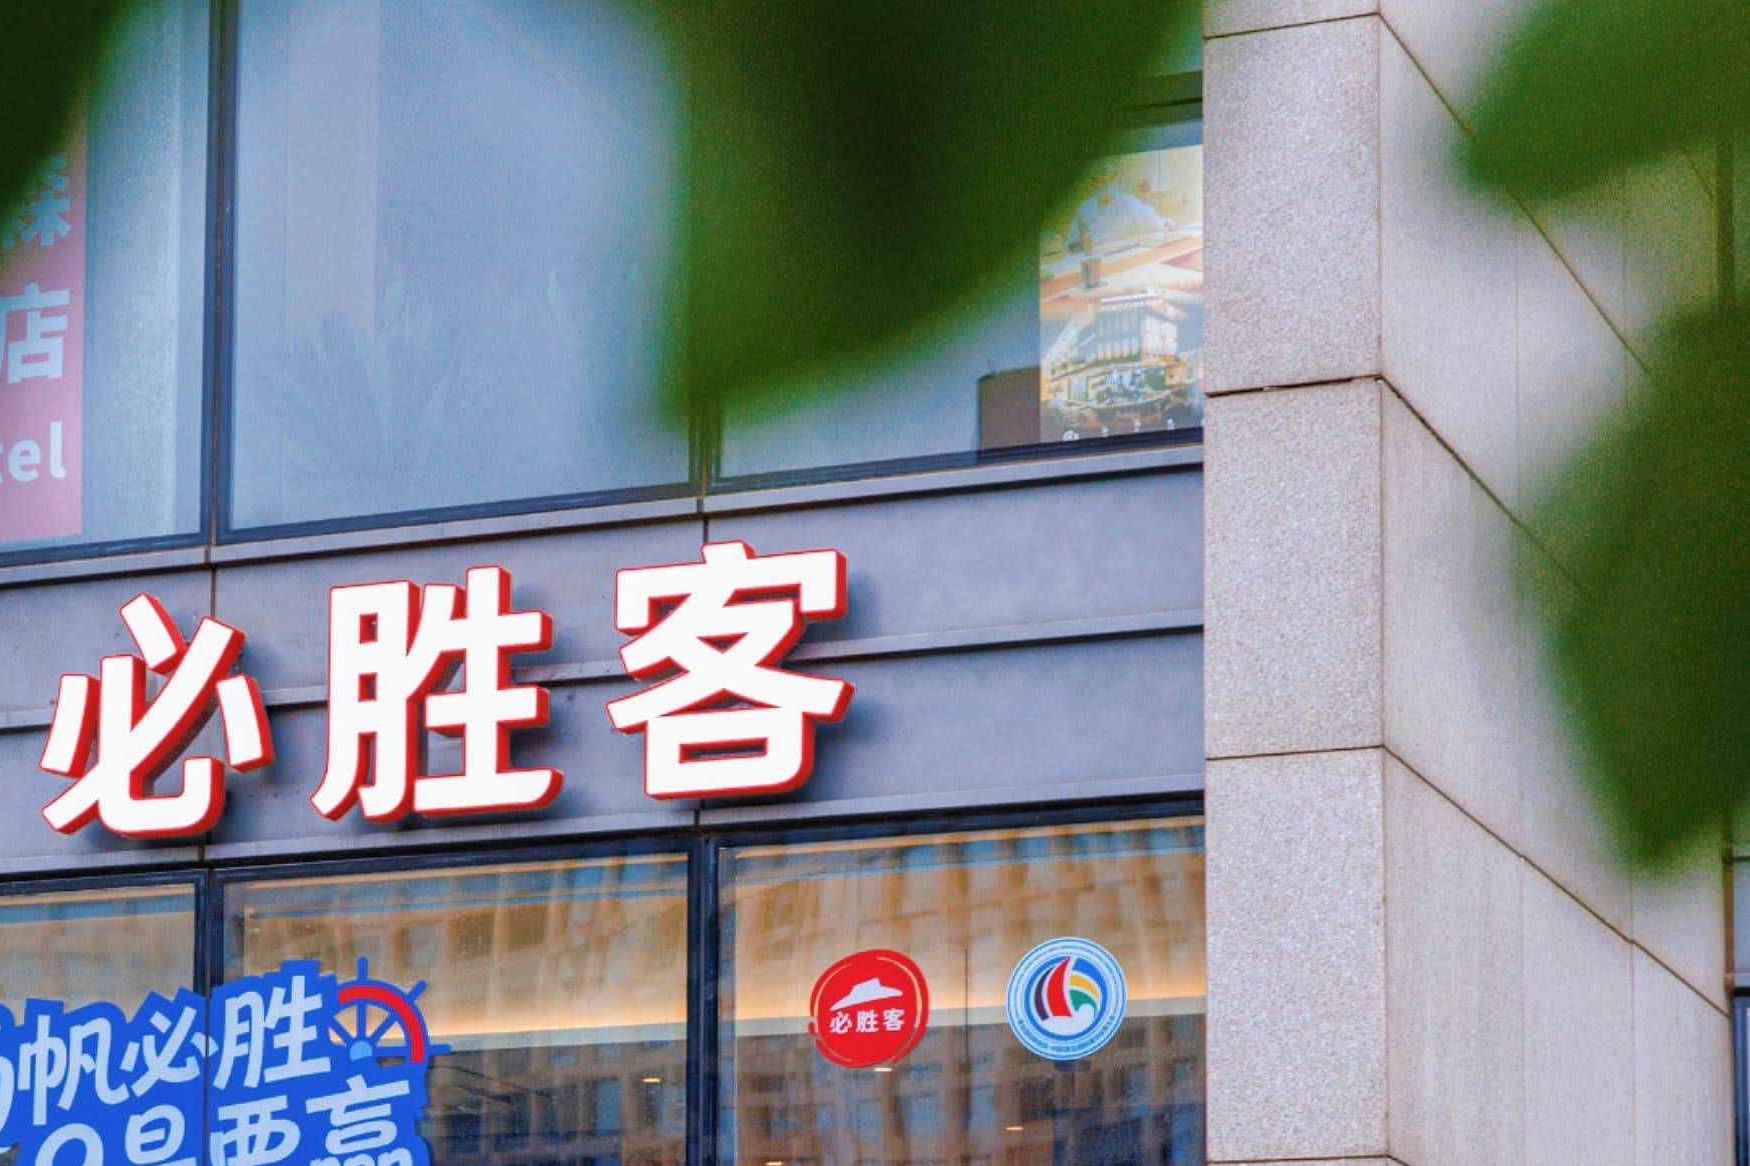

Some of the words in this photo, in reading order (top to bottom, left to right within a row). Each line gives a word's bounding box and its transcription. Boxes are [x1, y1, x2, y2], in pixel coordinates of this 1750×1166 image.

[41, 541, 855, 838] 必胜客
[830, 1008, 905, 1034] 必胜客
